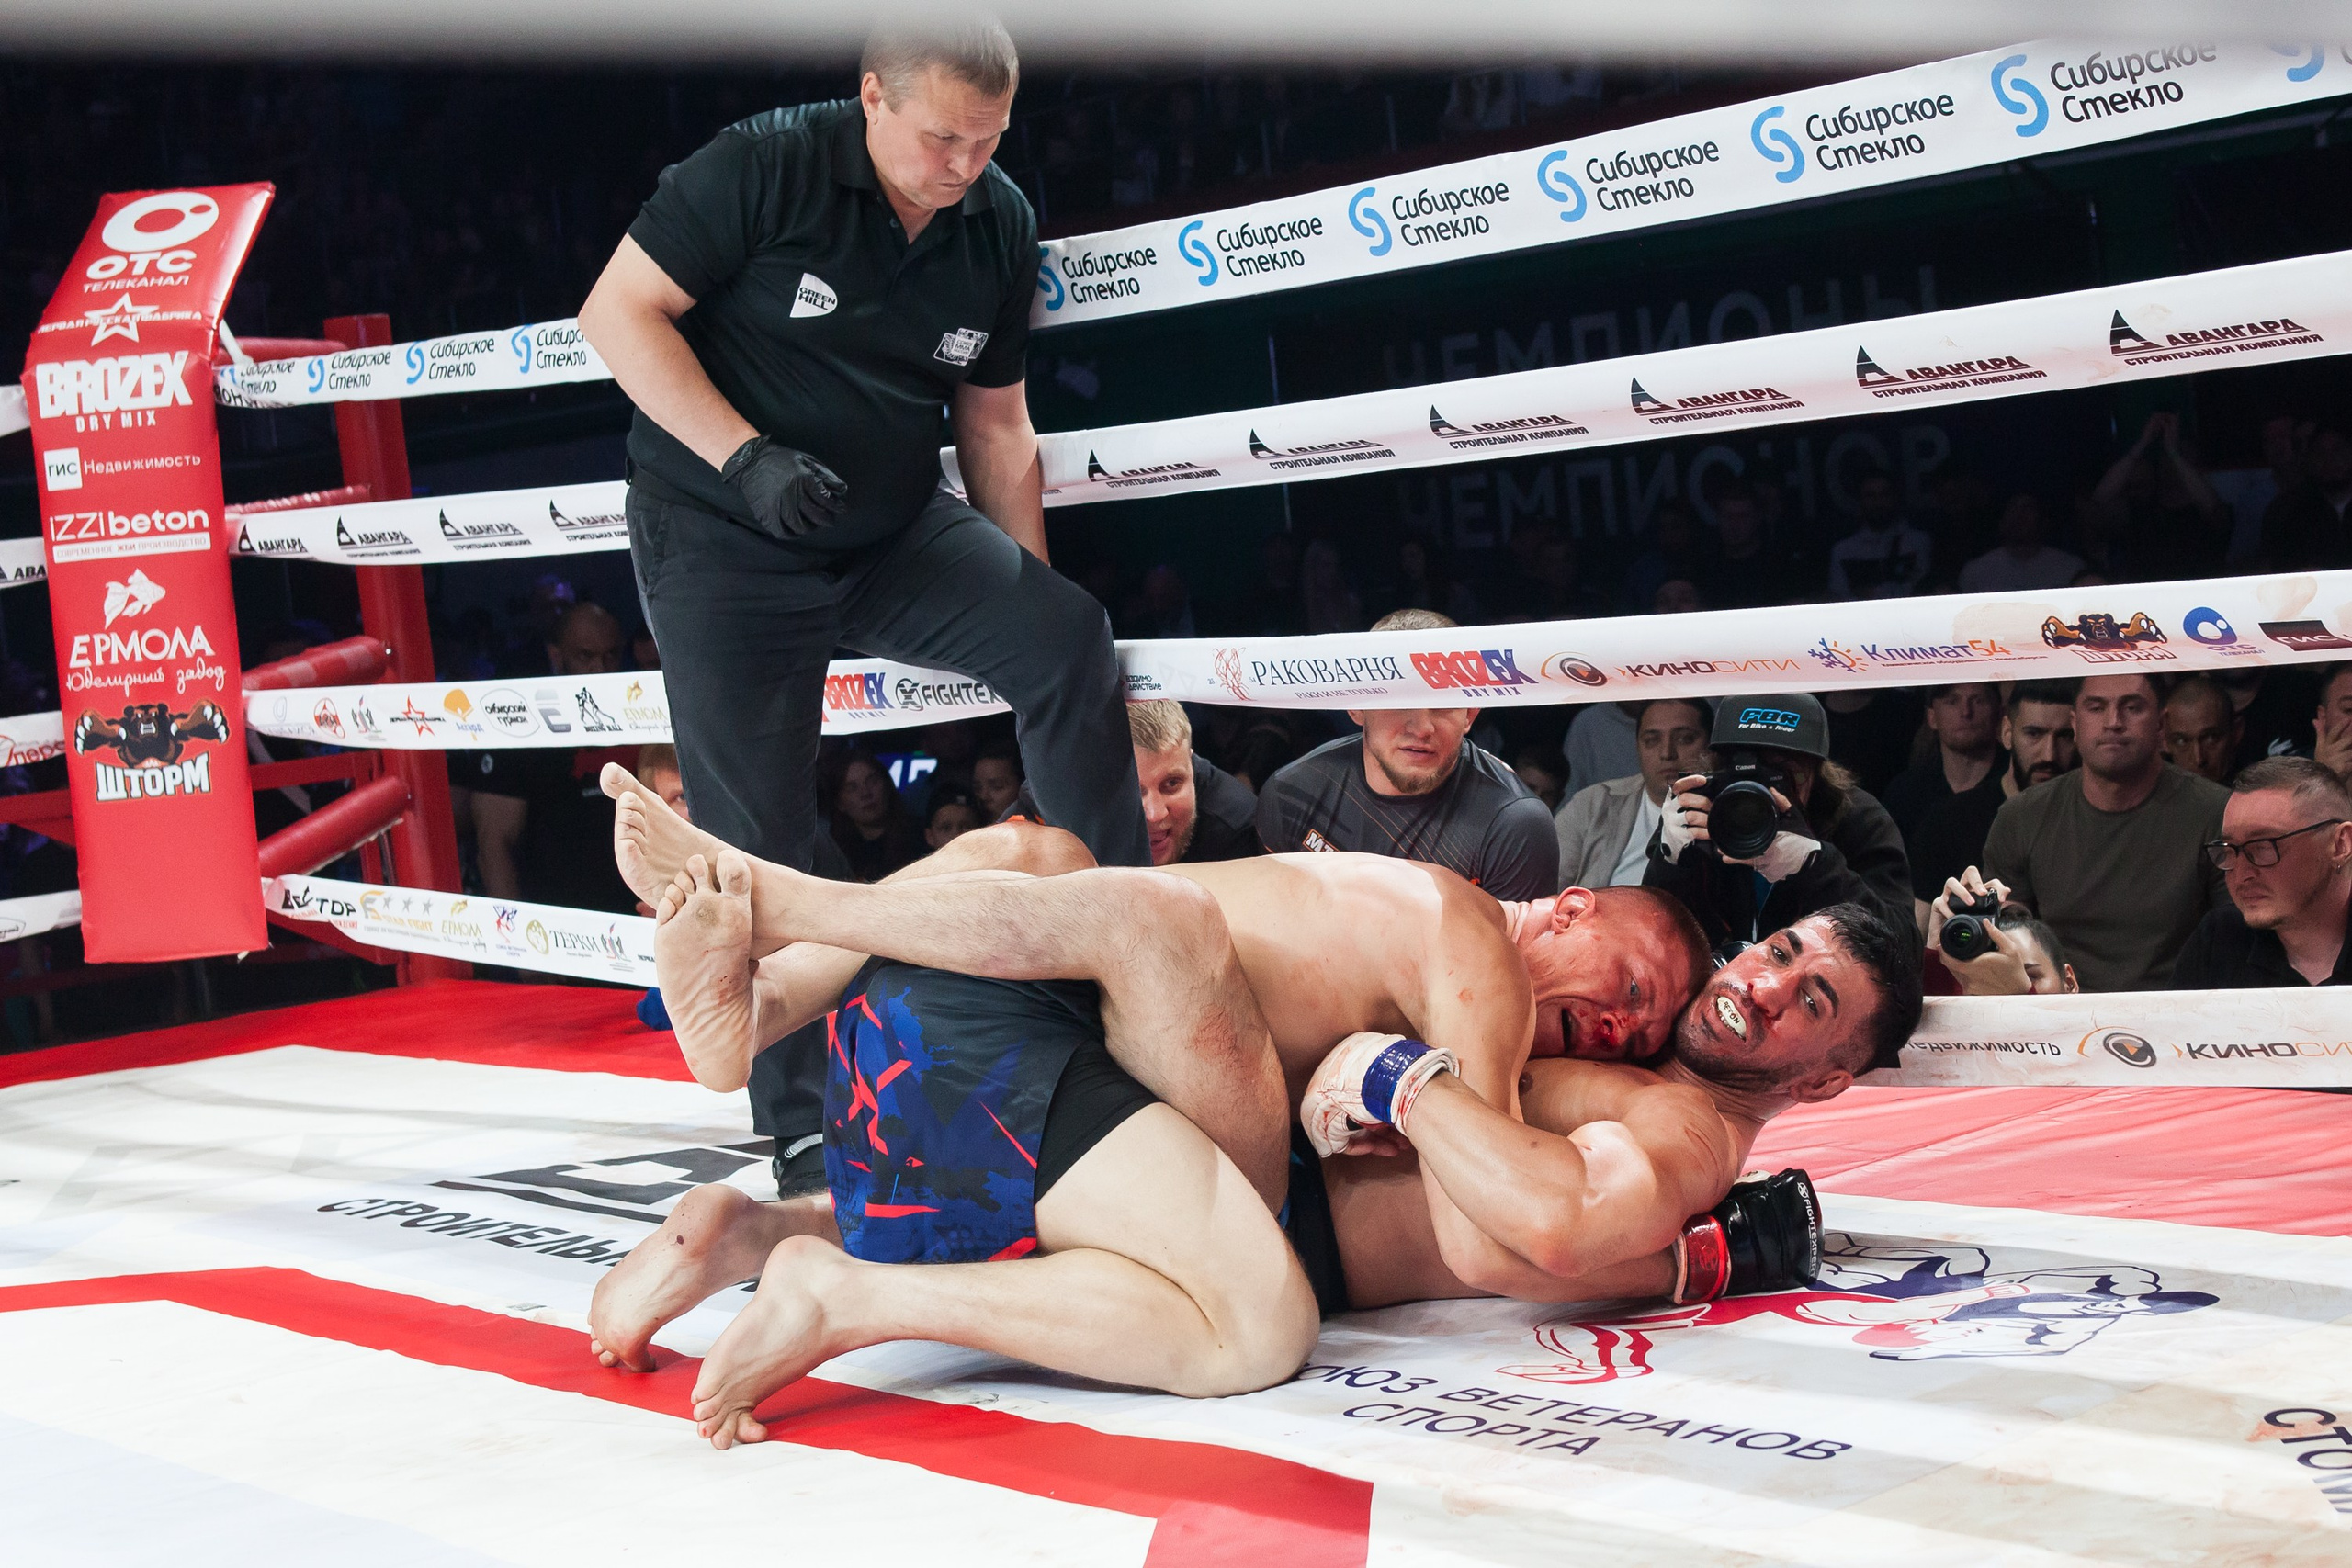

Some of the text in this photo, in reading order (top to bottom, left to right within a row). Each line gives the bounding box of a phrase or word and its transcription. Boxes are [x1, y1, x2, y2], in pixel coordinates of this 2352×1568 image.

[2051, 44, 2217, 91] Сибирское
[2062, 81, 2184, 123] Стекло
[1806, 94, 1954, 141] Сибирское
[1586, 141, 1720, 184] Сибирское
[1816, 134, 1925, 171] Стекло
[1392, 182, 1510, 220] Сибирское
[1597, 177, 1694, 211] Стекло
[1217, 217, 1323, 252] Сибирское
[1401, 215, 1490, 246] Стекло
[86, 252, 197, 280] ОТС
[1062, 247, 1157, 279] Сибирское
[1227, 248, 1305, 277] Стекло
[83, 275, 190, 294] ТЕЛЕКАНАЛ
[799, 287, 835, 305] GREEN
[1071, 276, 1140, 304] Стекло
[798, 294, 829, 310] HILL
[537, 327, 585, 349] Сибирс
[2165, 319, 2311, 347] АВАНГАРД
[430, 337, 495, 360] Сибирское
[537, 350, 587, 368] Стекло
[2124, 334, 2324, 367] СТРОИТЕЛЬНАЯ КОМПАНИЯ
[331, 351, 391, 372] Сибирское
[429, 361, 476, 380] Стекло
[1905, 356, 2034, 380] АВАНГАРД
[36, 351, 193, 419] BROZEX
[329, 372, 371, 389] Стекло
[1872, 370, 2047, 398] СТРОИТЕЛЬНАЯ КОМПАНИЯ
[1676, 387, 1792, 409] АВАНГАРД
[75, 410, 156, 433] DRY MIX
[1472, 414, 1576, 433] АВАНГАРД
[1649, 400, 1805, 425] СТРОИТЕЛЬНАЯ КОМПАНИЯ
[1449, 427, 1589, 450] СТРОИТЕЛЬНАЯ КОМПАНИЯ
[48, 454, 201, 478] ГИС Недвижимость
[1269, 449, 1396, 469] СТРОИТЕЛЬНАЯ КОМПАНИЯ
[1106, 469, 1221, 488] СТРОИТЕЛЬНАЯ КОМПАНИЯ
[358, 530, 413, 545] АВАНГАРД
[463, 522, 523, 536] АВАНГАРД
[258, 537, 308, 553] АВАНГАРД
[69, 625, 215, 669] ЕРМОЛА
[1860, 639, 2012, 661] Климат54
[2277, 635, 2338, 644] ГИС
[2071, 646, 2178, 663] ШТОРМ
[66, 657, 227, 697] Ювелирный завод
[1251, 656, 1406, 686] РАКОВАРНЯ
[1409, 649, 1539, 689] BROZEX
[1626, 659, 1801, 678] КИНОСИТИ
[1462, 686, 1522, 698] DRY MIX
[1739, 708, 1801, 728] FBR
[1775, 725, 1795, 733] Rider
[96, 751, 210, 802] ШТОРМ
[2186, 1042, 2352, 1059] КИНОСИ
[317, 1198, 630, 1267] СТРОИТЕЛЬ
[1804, 1198, 1818, 1278] FIGHTEXPERT
[1292, 1362, 1852, 1461] ОЮЗ ВЕТЕРАНОВ
[1342, 1403, 1601, 1456] СПОРТА
